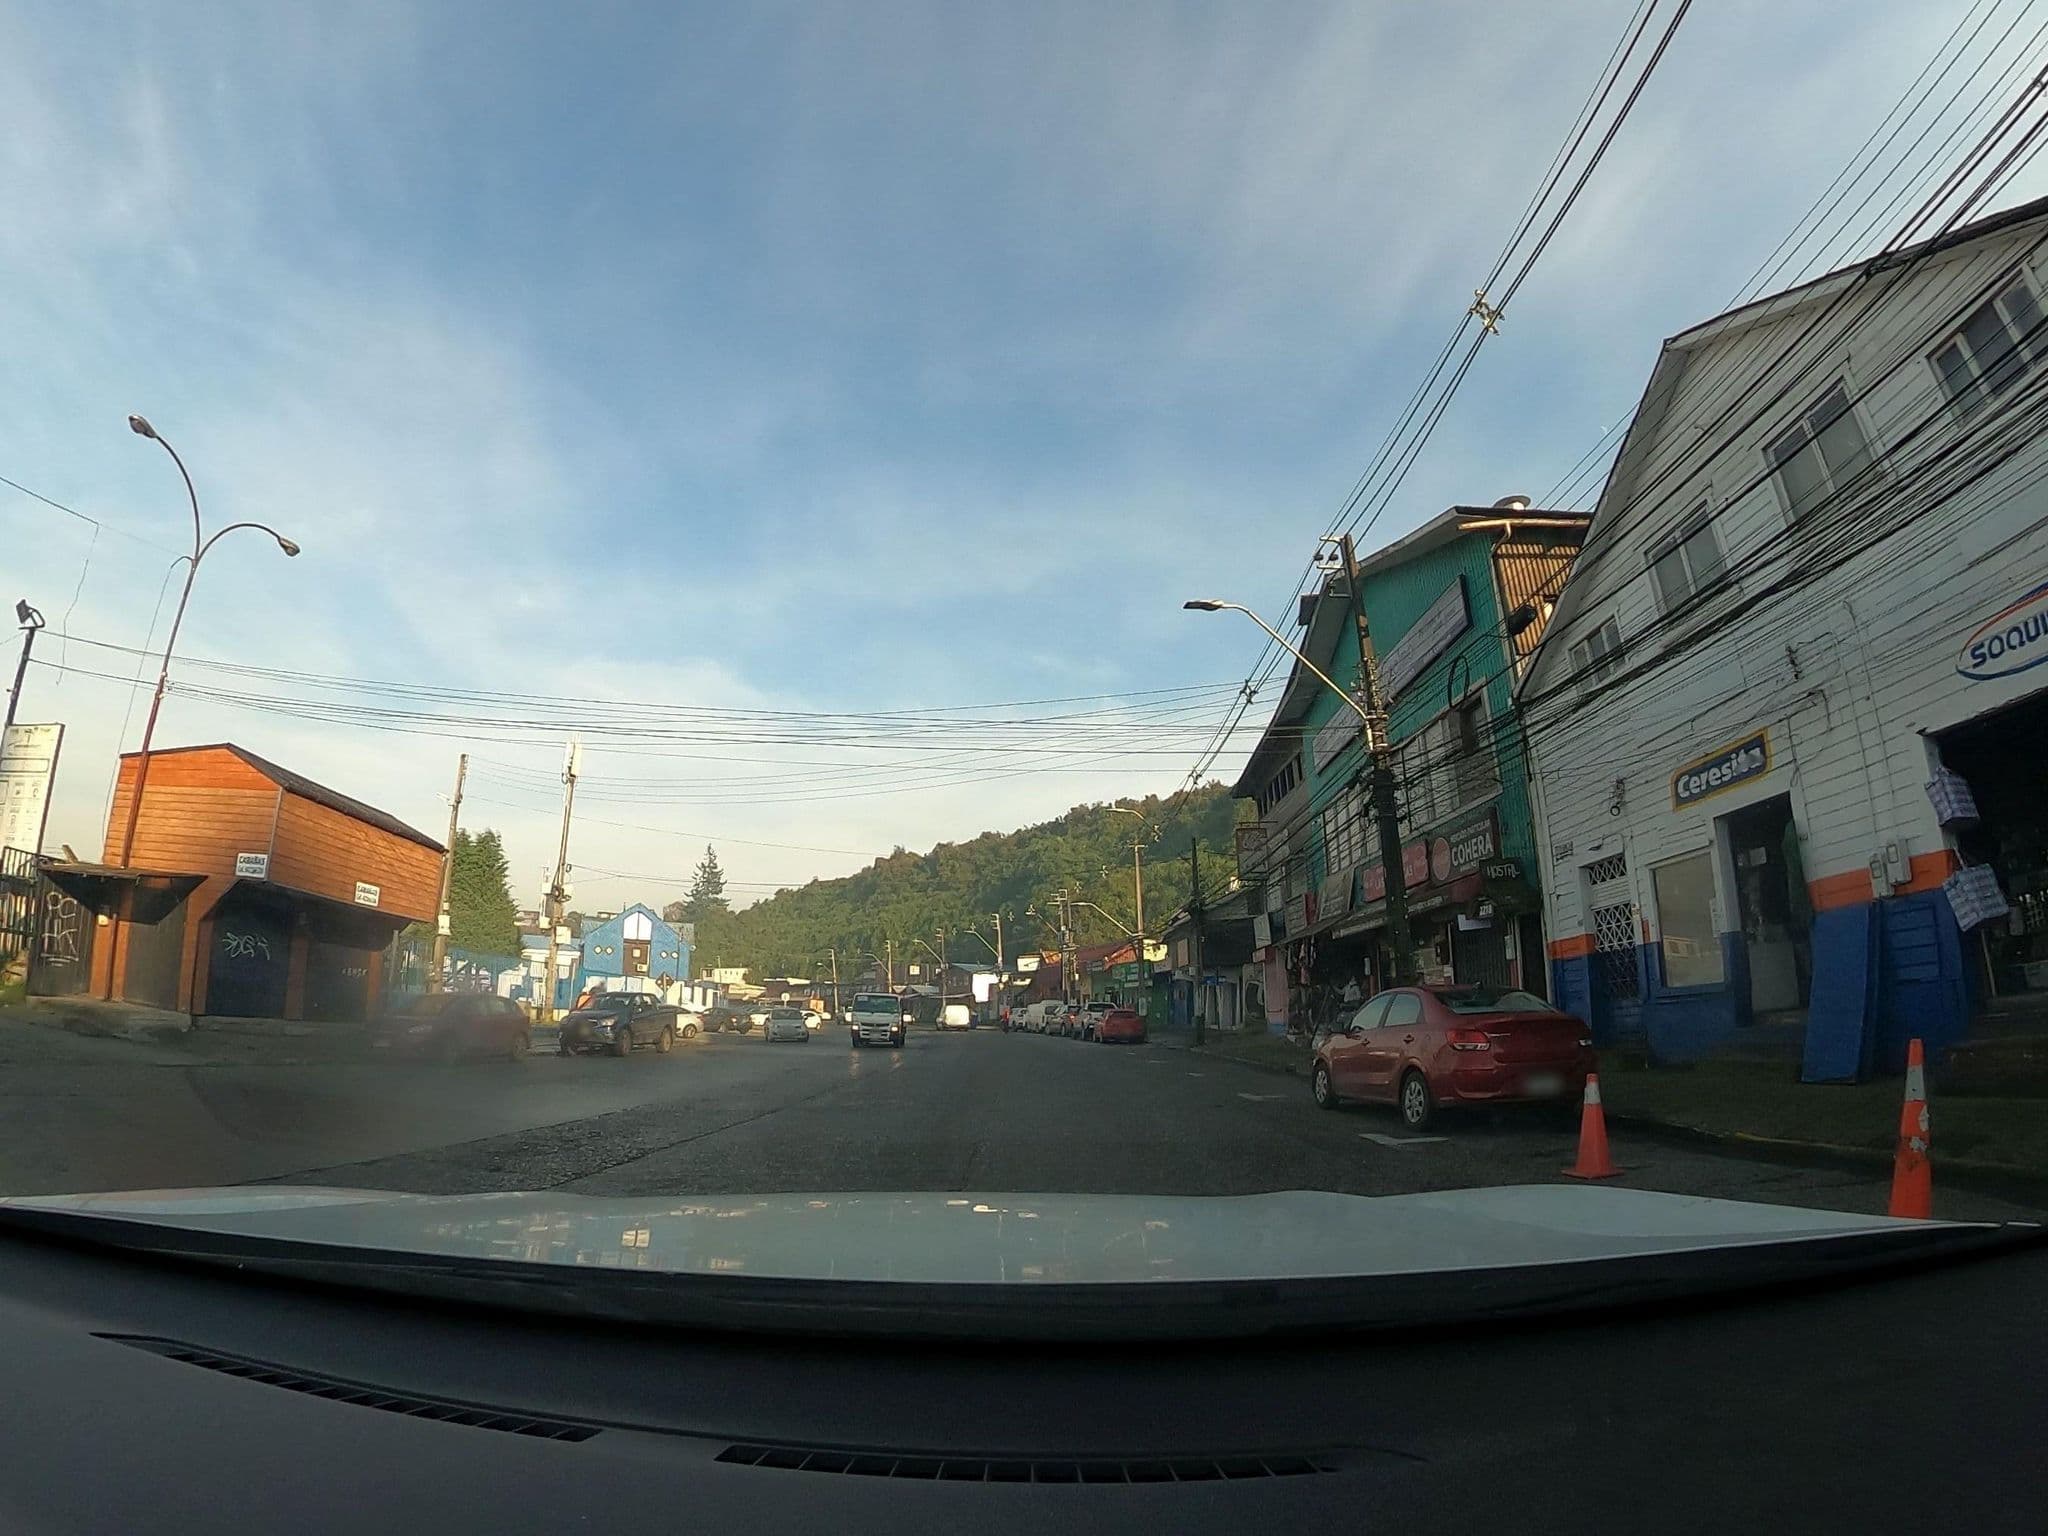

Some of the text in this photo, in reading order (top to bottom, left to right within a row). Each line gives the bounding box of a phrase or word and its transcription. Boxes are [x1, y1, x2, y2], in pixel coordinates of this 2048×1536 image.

[1970, 609, 2048, 669] SOQUI
[1451, 833, 1494, 866] COHERA
[1486, 863, 1520, 879] HOSTAL
